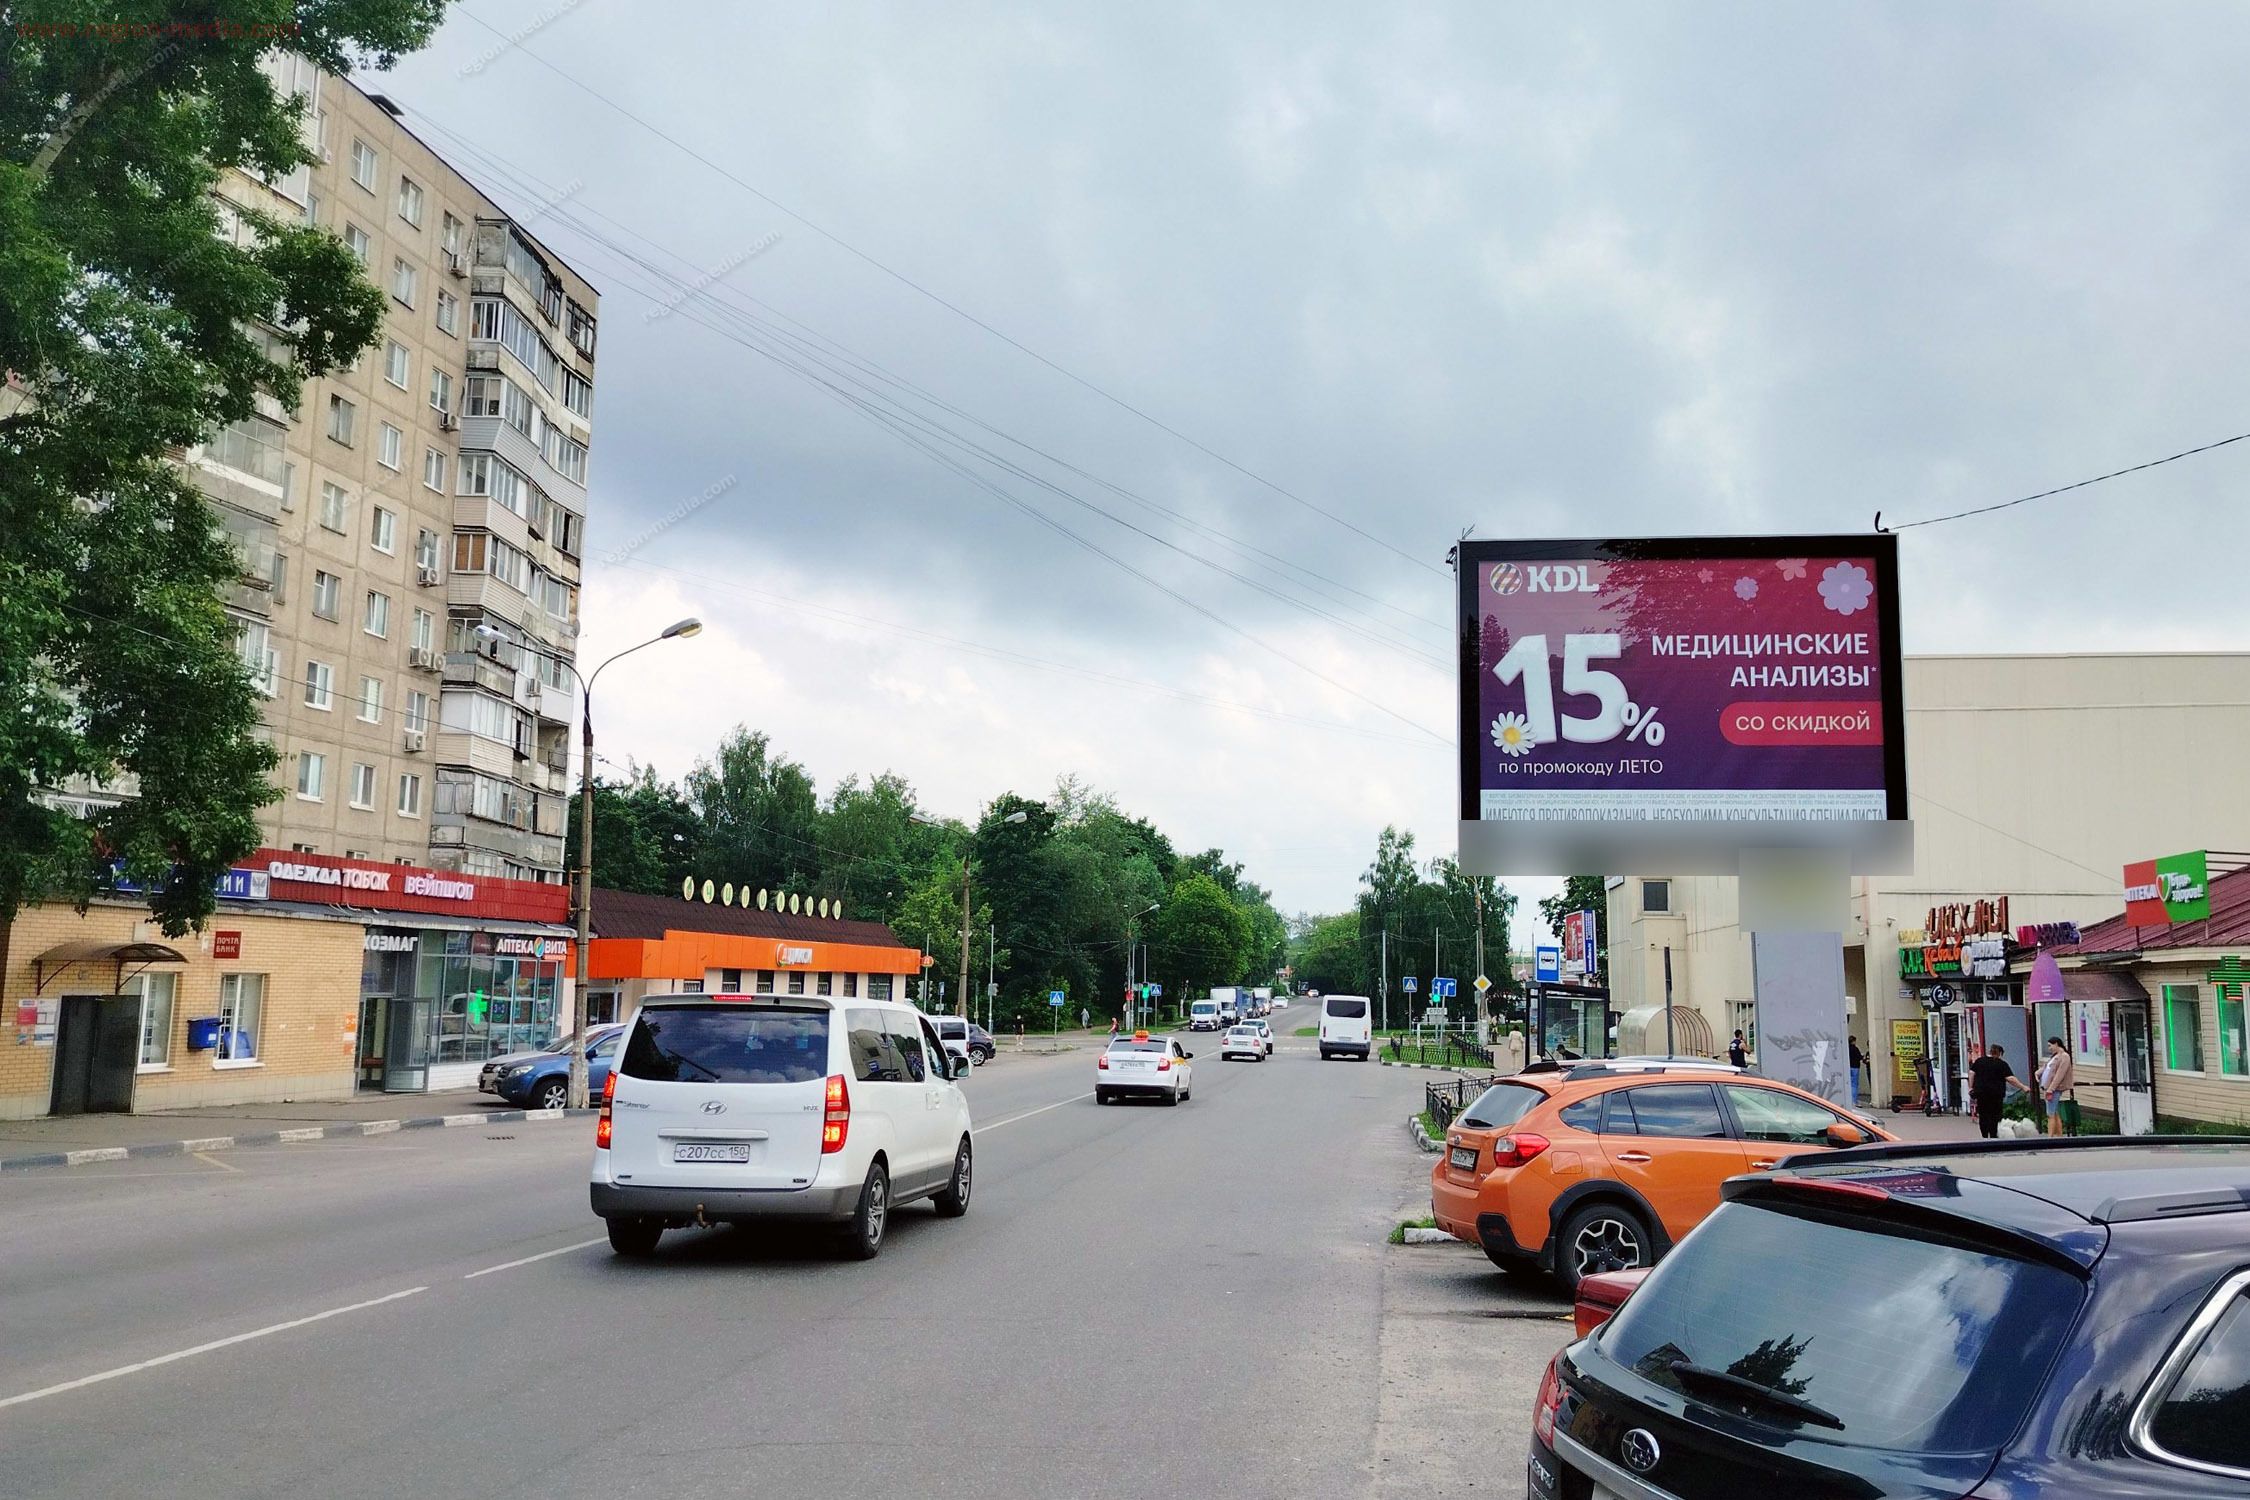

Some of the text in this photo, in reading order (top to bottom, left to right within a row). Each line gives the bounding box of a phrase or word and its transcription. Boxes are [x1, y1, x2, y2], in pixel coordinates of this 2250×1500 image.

[1527, 565, 1600, 593] KDL
[1652, 633, 1869, 658] МЕДИЦИНСКИЕ
[1499, 759, 1664, 776] по промокоду ЛЕТО
[269, 861, 342, 886] ОДЕЖДА
[216, 936, 239, 945] ПОЧТА
[497, 938, 568, 954] АПТЕКА ВИТА
[216, 945, 236, 953] БАНК
[1937, 989, 1950, 998] 24
